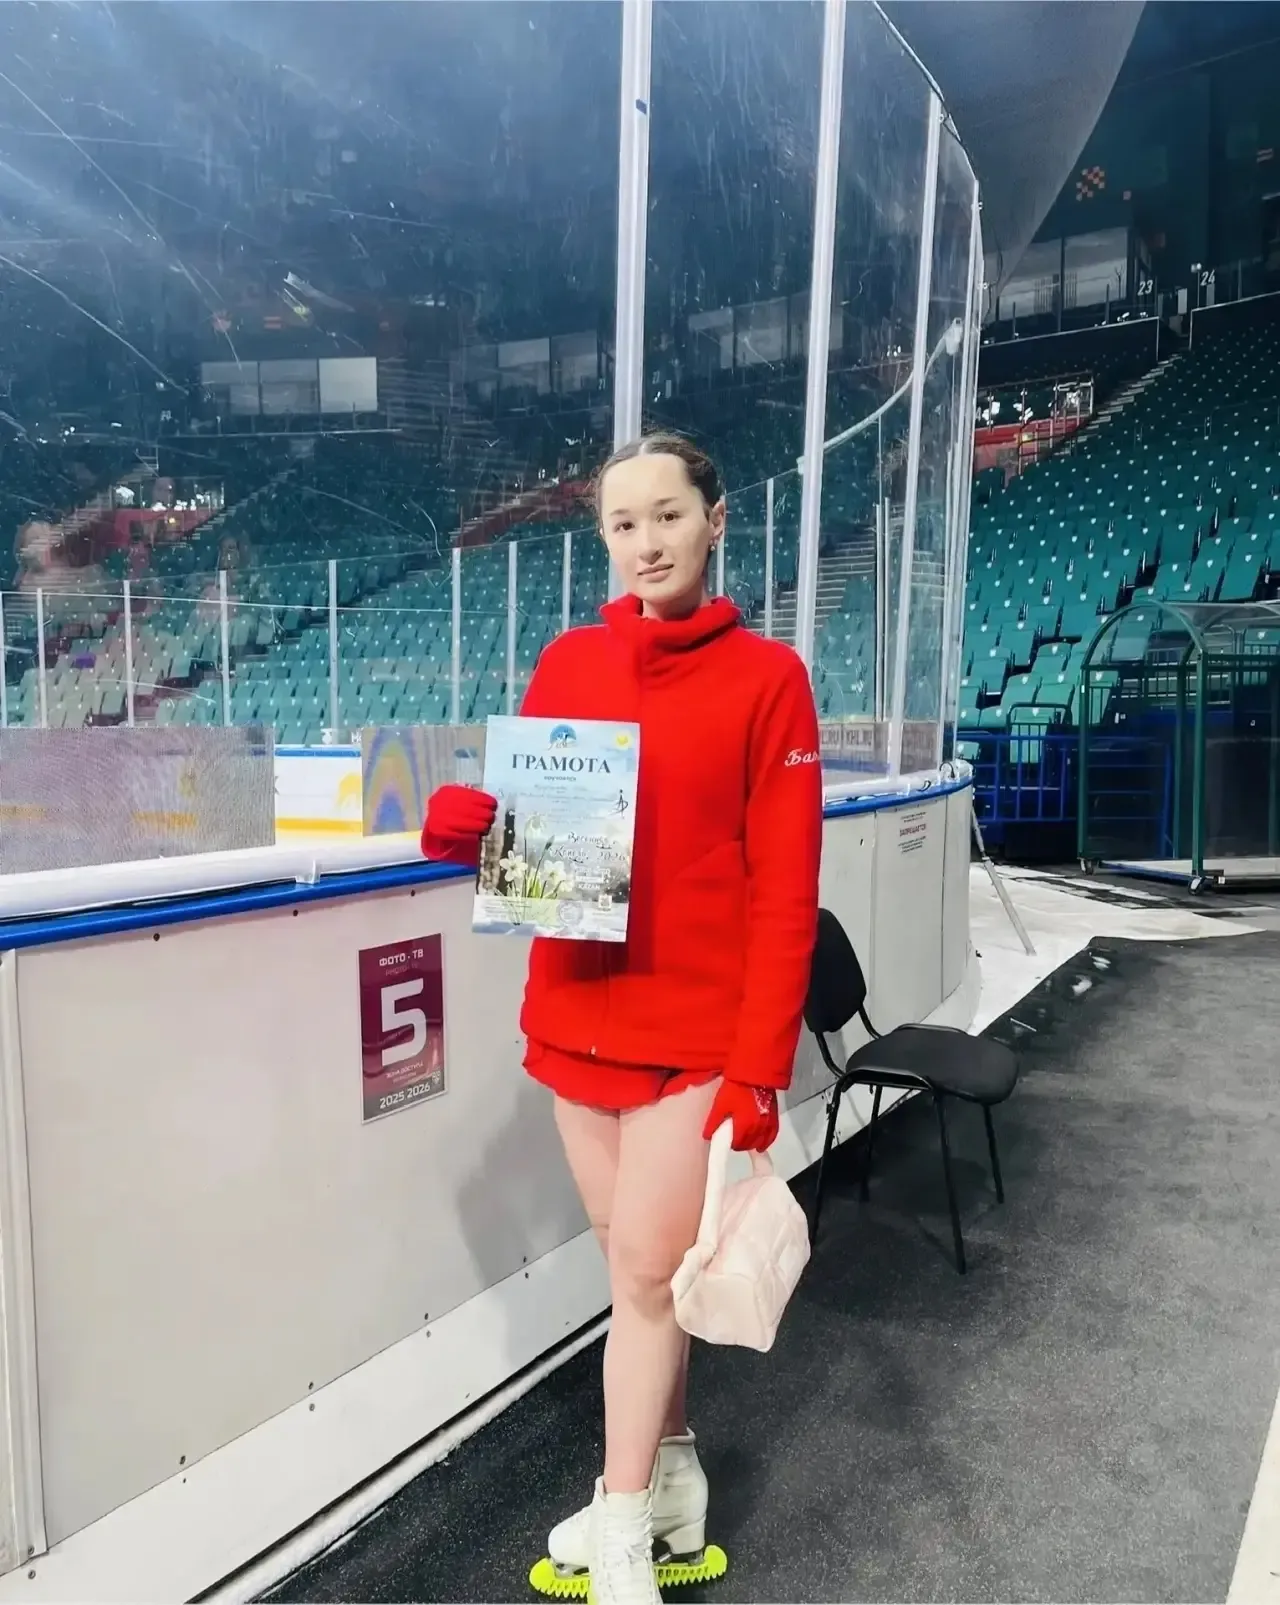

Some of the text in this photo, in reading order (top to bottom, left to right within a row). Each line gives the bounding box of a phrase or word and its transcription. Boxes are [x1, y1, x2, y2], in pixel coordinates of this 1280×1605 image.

[1137, 279, 1153, 296] 23
[1200, 269, 1215, 286] 24
[511, 753, 611, 774] ГРАМОТА
[379, 948, 424, 967] ФОТО ТВ
[381, 978, 427, 1067] 5
[379, 1082, 431, 1109] 2025 2026
